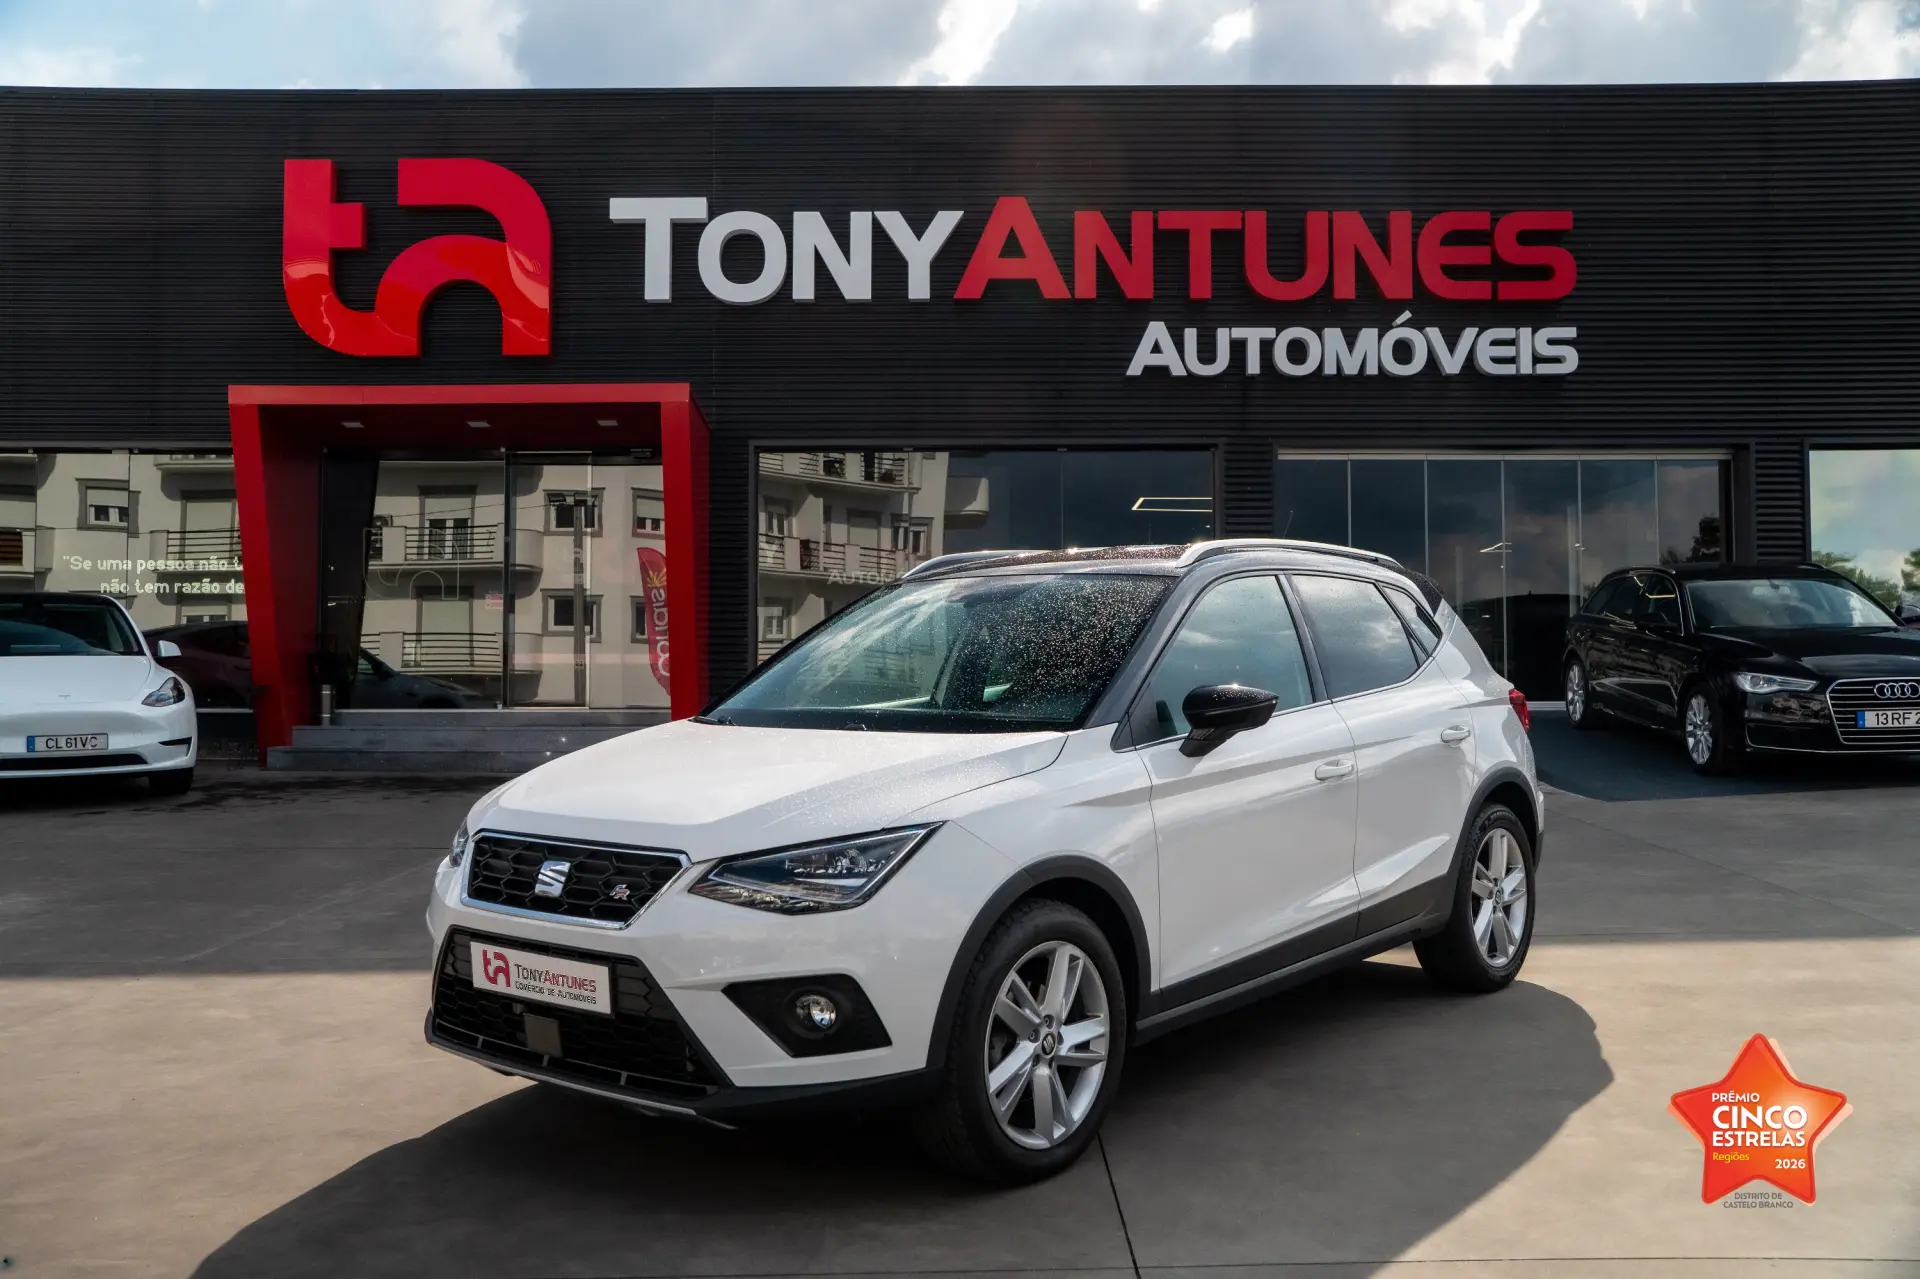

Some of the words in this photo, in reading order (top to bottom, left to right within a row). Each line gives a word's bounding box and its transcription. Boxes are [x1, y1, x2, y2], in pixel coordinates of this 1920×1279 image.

[1126, 310, 1579, 377] AUTOMÓVEIS
[97, 558, 132, 571] uma
[136, 559, 194, 574] pessoa
[200, 556, 228, 571] não
[100, 579, 129, 594] não
[134, 579, 170, 594] tem
[174, 579, 220, 594] razão
[547, 988, 555, 997] DE
